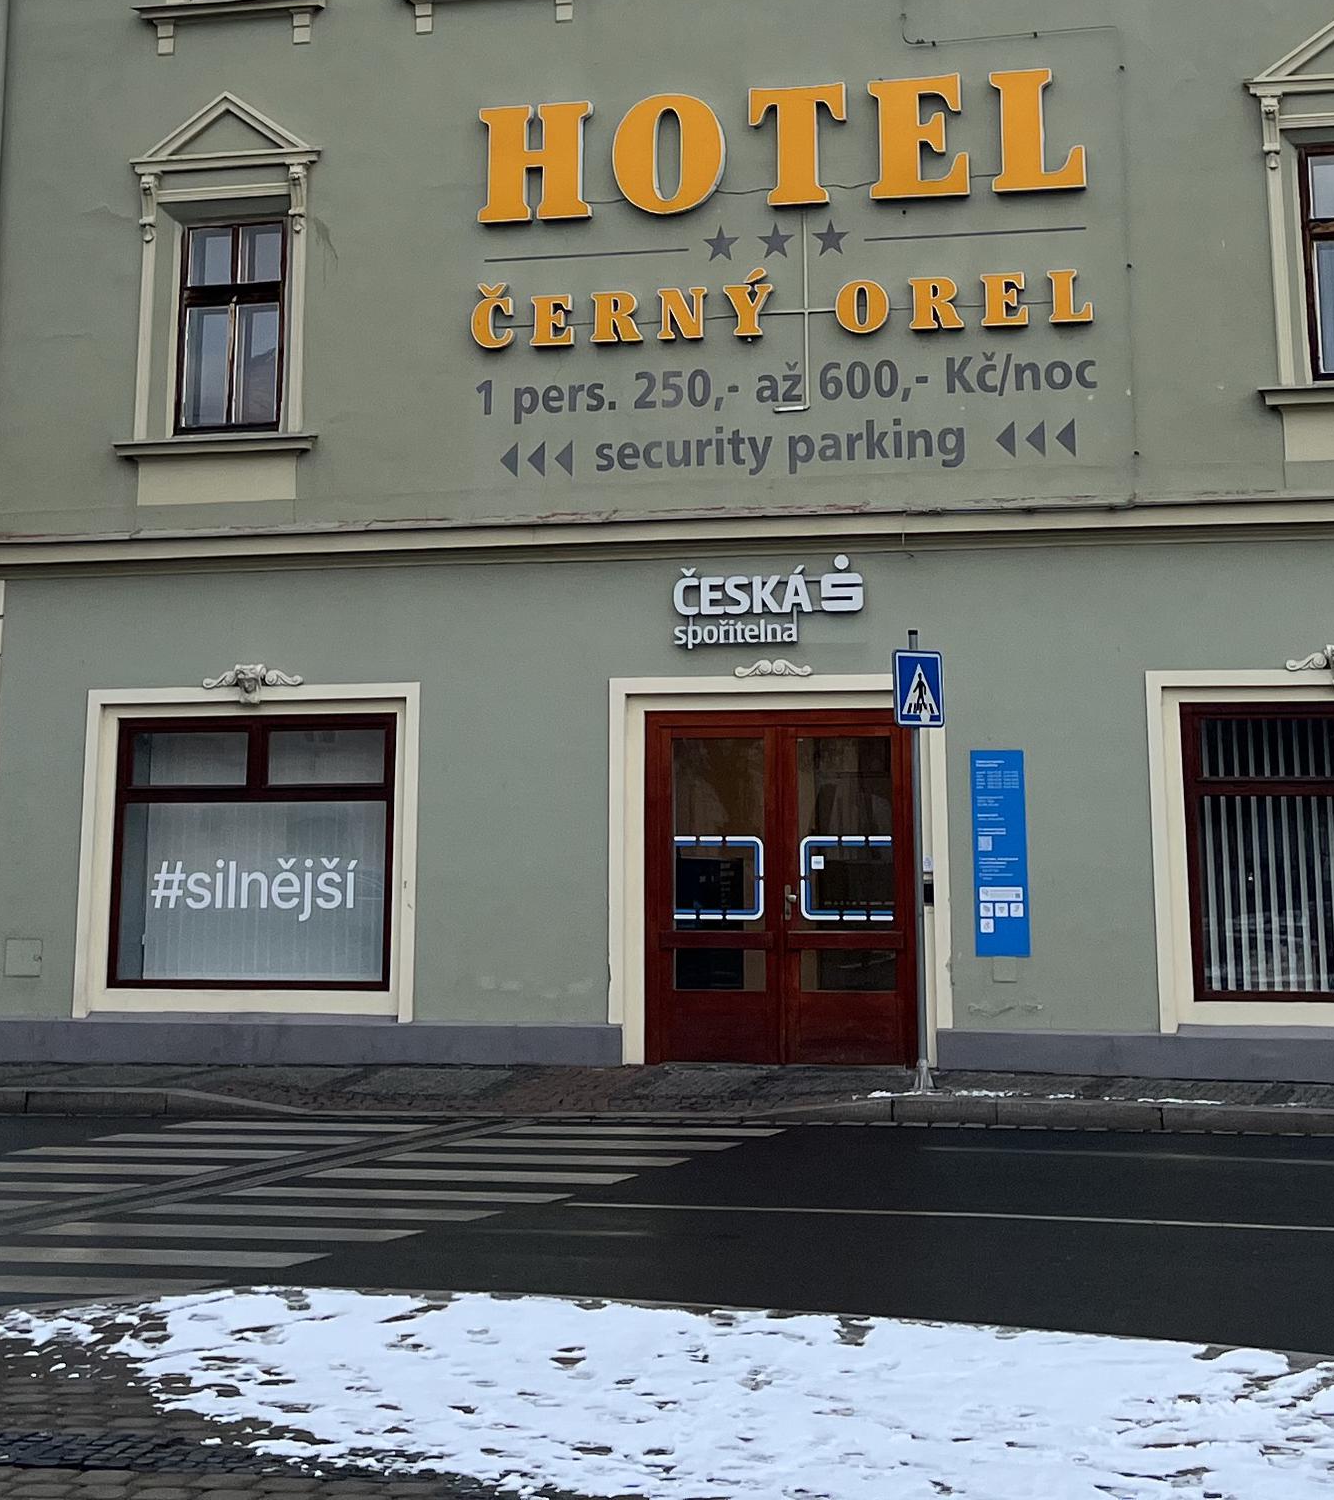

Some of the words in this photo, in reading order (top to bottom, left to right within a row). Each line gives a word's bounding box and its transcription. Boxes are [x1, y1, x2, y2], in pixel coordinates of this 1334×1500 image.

[477, 67, 1088, 224] HOTEL
[470, 267, 773, 349] ČERNÝ
[834, 268, 1094, 334] OREL
[475, 379, 493, 415] 1
[513, 381, 617, 425] pers.
[633, 368, 740, 412] 250,-
[755, 361, 803, 403] až
[818, 359, 929, 403] 600,-
[945, 351, 1098, 397] Kč/noc
[595, 425, 773, 476] security
[787, 417, 966, 475] parking
[673, 564, 813, 616] ČESKÁ
[673, 619, 798, 650] spořitelna
[150, 857, 359, 922] #silnější
